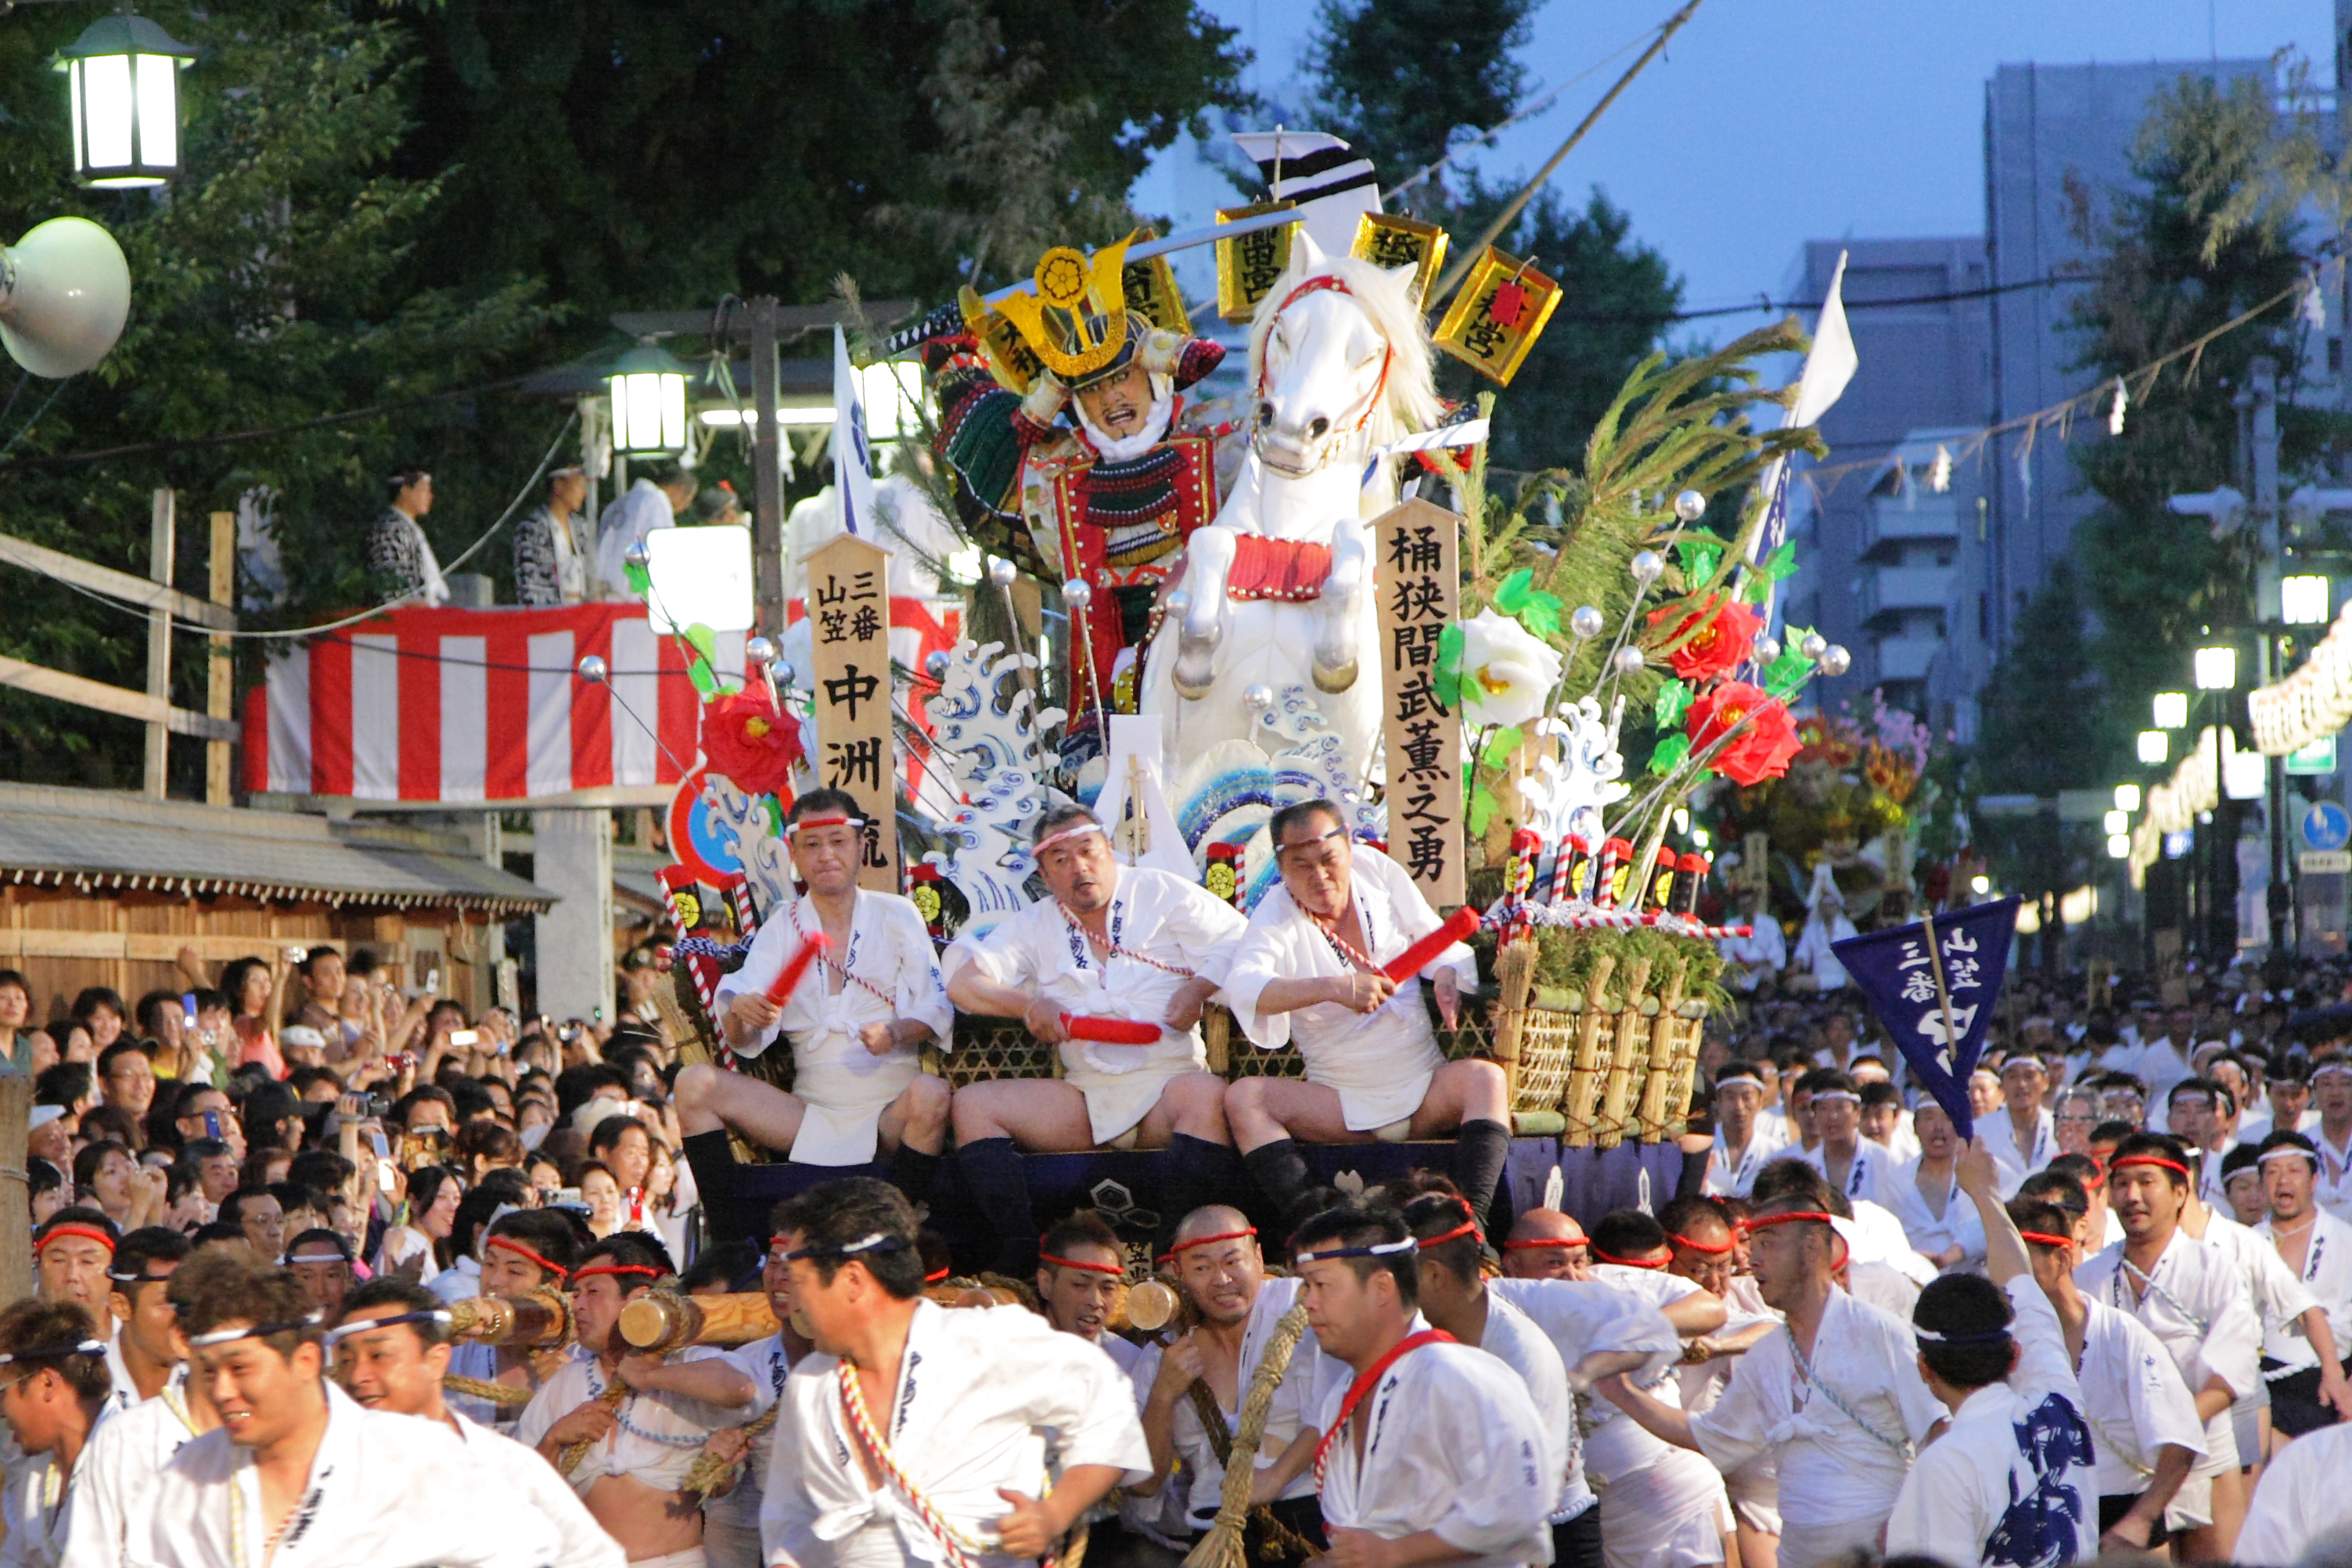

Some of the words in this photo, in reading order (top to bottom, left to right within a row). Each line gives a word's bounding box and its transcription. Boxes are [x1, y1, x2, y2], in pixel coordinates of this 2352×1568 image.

[816, 574, 847, 644] 山笠
[849, 571, 883, 642] 三番
[1387, 525, 1450, 883] 桶狭間武薫之勇
